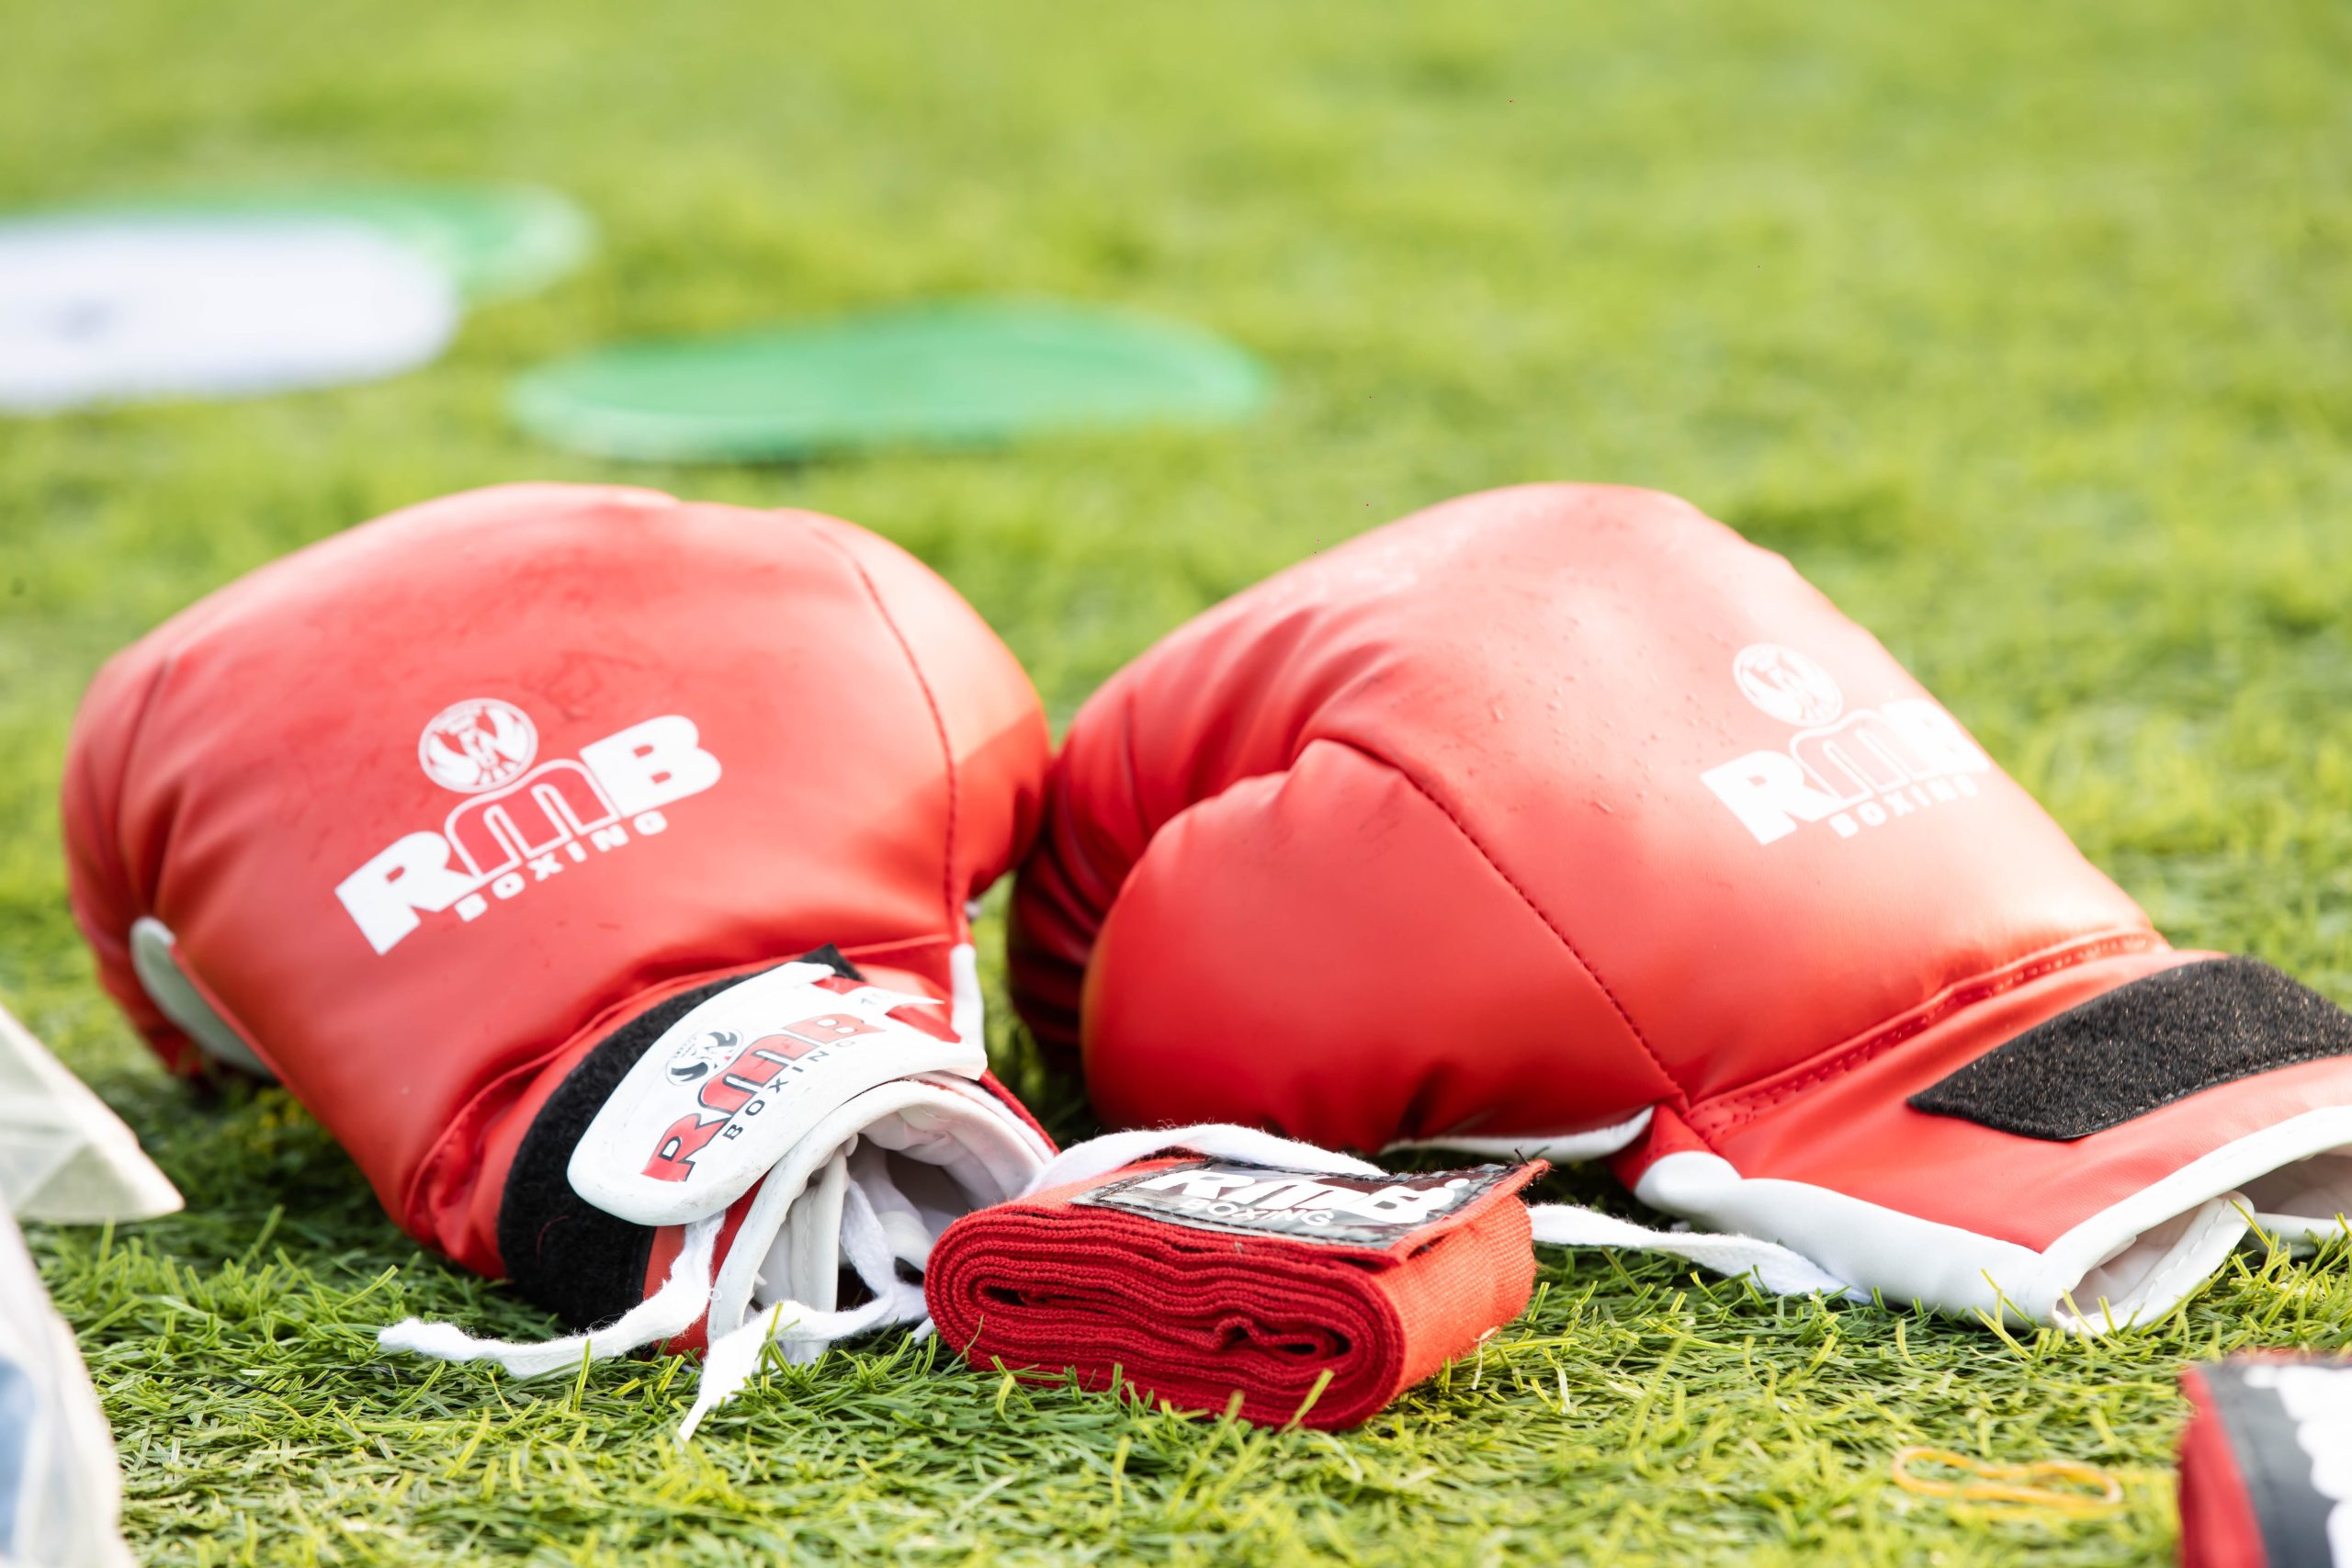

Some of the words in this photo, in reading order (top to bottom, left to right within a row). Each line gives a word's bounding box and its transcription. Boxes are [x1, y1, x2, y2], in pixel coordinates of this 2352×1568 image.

[334, 715, 722, 956] RMB
[1700, 699, 1990, 845] RMB
[454, 810, 668, 922] BOXING
[640, 1013, 887, 1182] RMB
[723, 1040, 855, 1140] BOXING
[1179, 1198, 1334, 1226] BOXING
